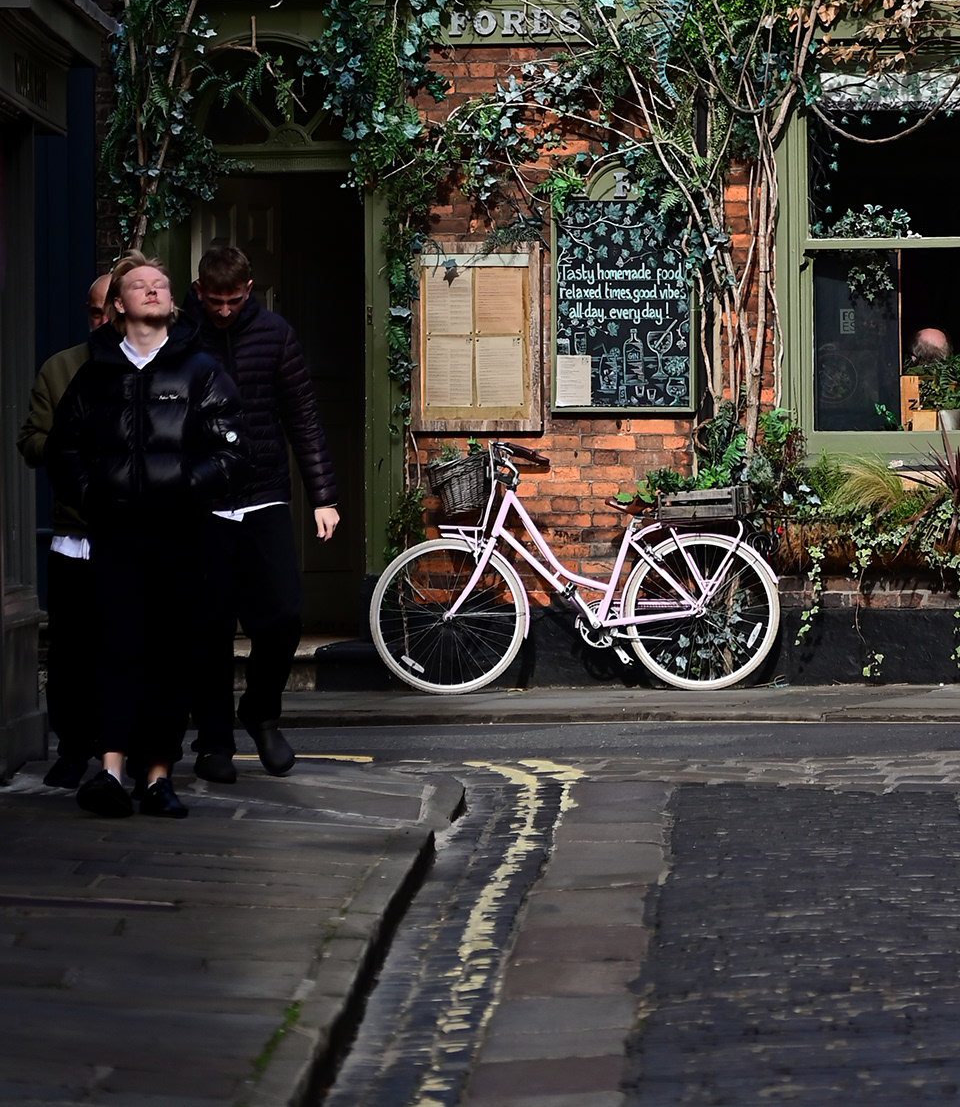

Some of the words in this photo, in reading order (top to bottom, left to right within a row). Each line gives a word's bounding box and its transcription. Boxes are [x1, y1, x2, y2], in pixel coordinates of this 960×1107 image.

[613, 172, 631, 199] F
[558, 263, 595, 285] Tasty
[597, 262, 652, 281] homemade
[656, 262, 683, 285] food
[559, 283, 602, 299] relaxed
[660, 283, 687, 300] vibes
